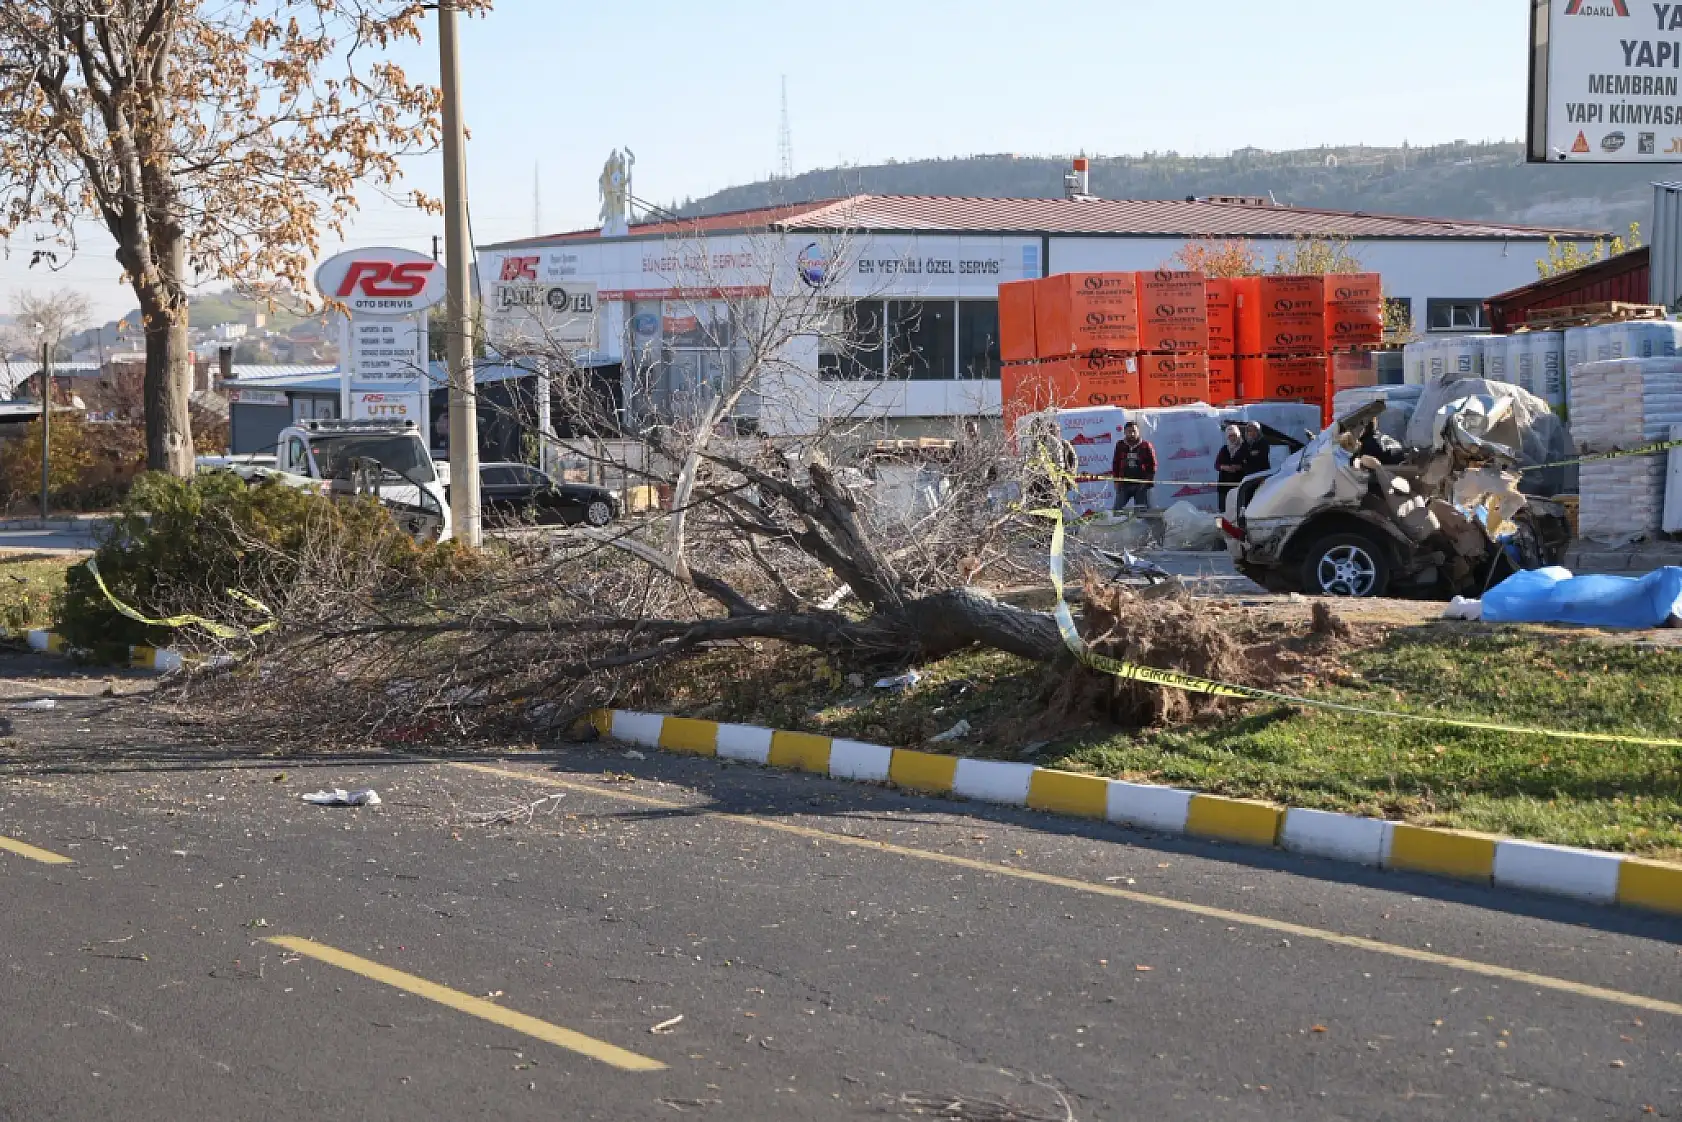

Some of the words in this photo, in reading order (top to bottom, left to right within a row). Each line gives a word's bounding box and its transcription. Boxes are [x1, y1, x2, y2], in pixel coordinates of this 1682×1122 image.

[1578, 6, 1614, 17] ADAKLI
[1620, 39, 1680, 68] YAPI
[1588, 74, 1678, 96] MEMBRAN
[1566, 103, 1603, 123] YAPI
[858, 259, 874, 274] EN
[926, 257, 955, 274] ÖZEL
[959, 258, 999, 274] SERVİS
[336, 261, 435, 297] RS
[355, 300, 376, 308] OTO
[378, 300, 413, 308] SERVİS
